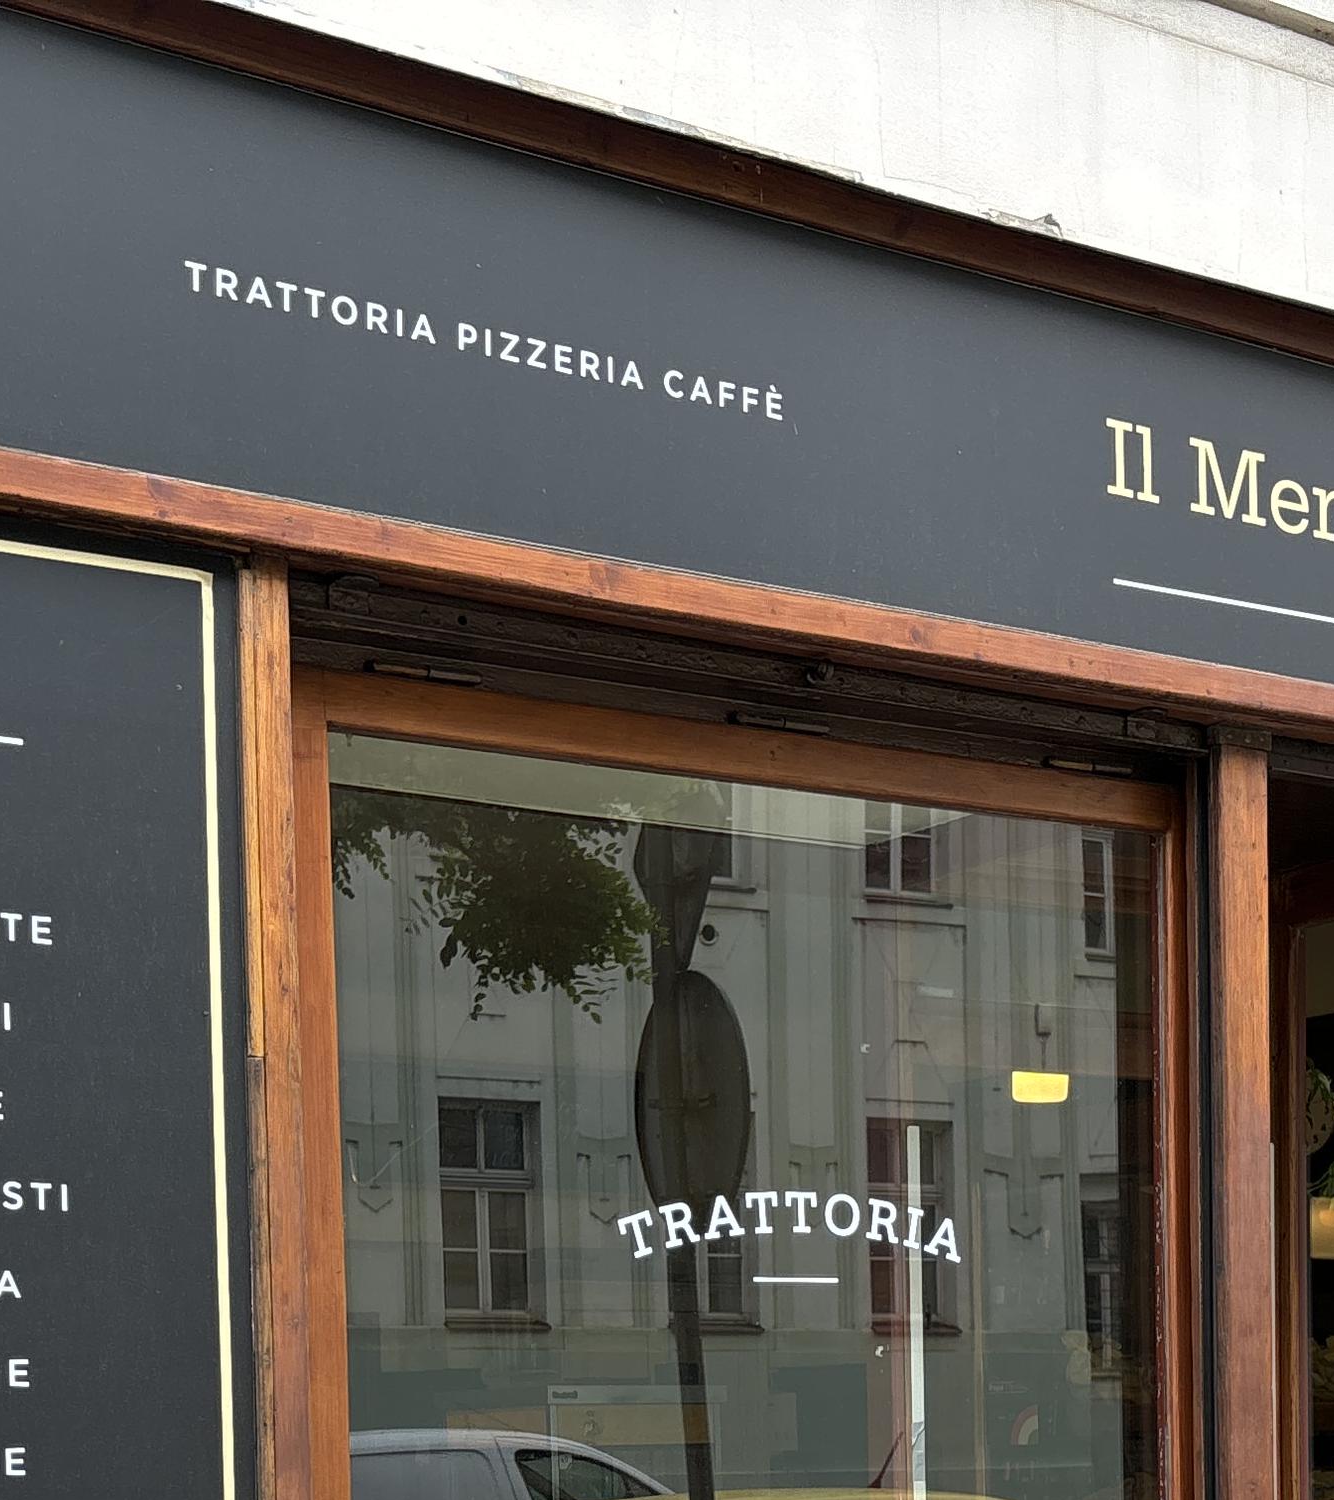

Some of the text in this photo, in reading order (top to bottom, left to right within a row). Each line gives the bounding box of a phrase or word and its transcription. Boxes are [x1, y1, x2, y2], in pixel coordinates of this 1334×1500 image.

[184, 260, 784, 421] TRATTORIA PIZZERIA CAFFÈ
[1105, 417, 1160, 504] Il
[617, 1190, 962, 1264] TRATTORIA
